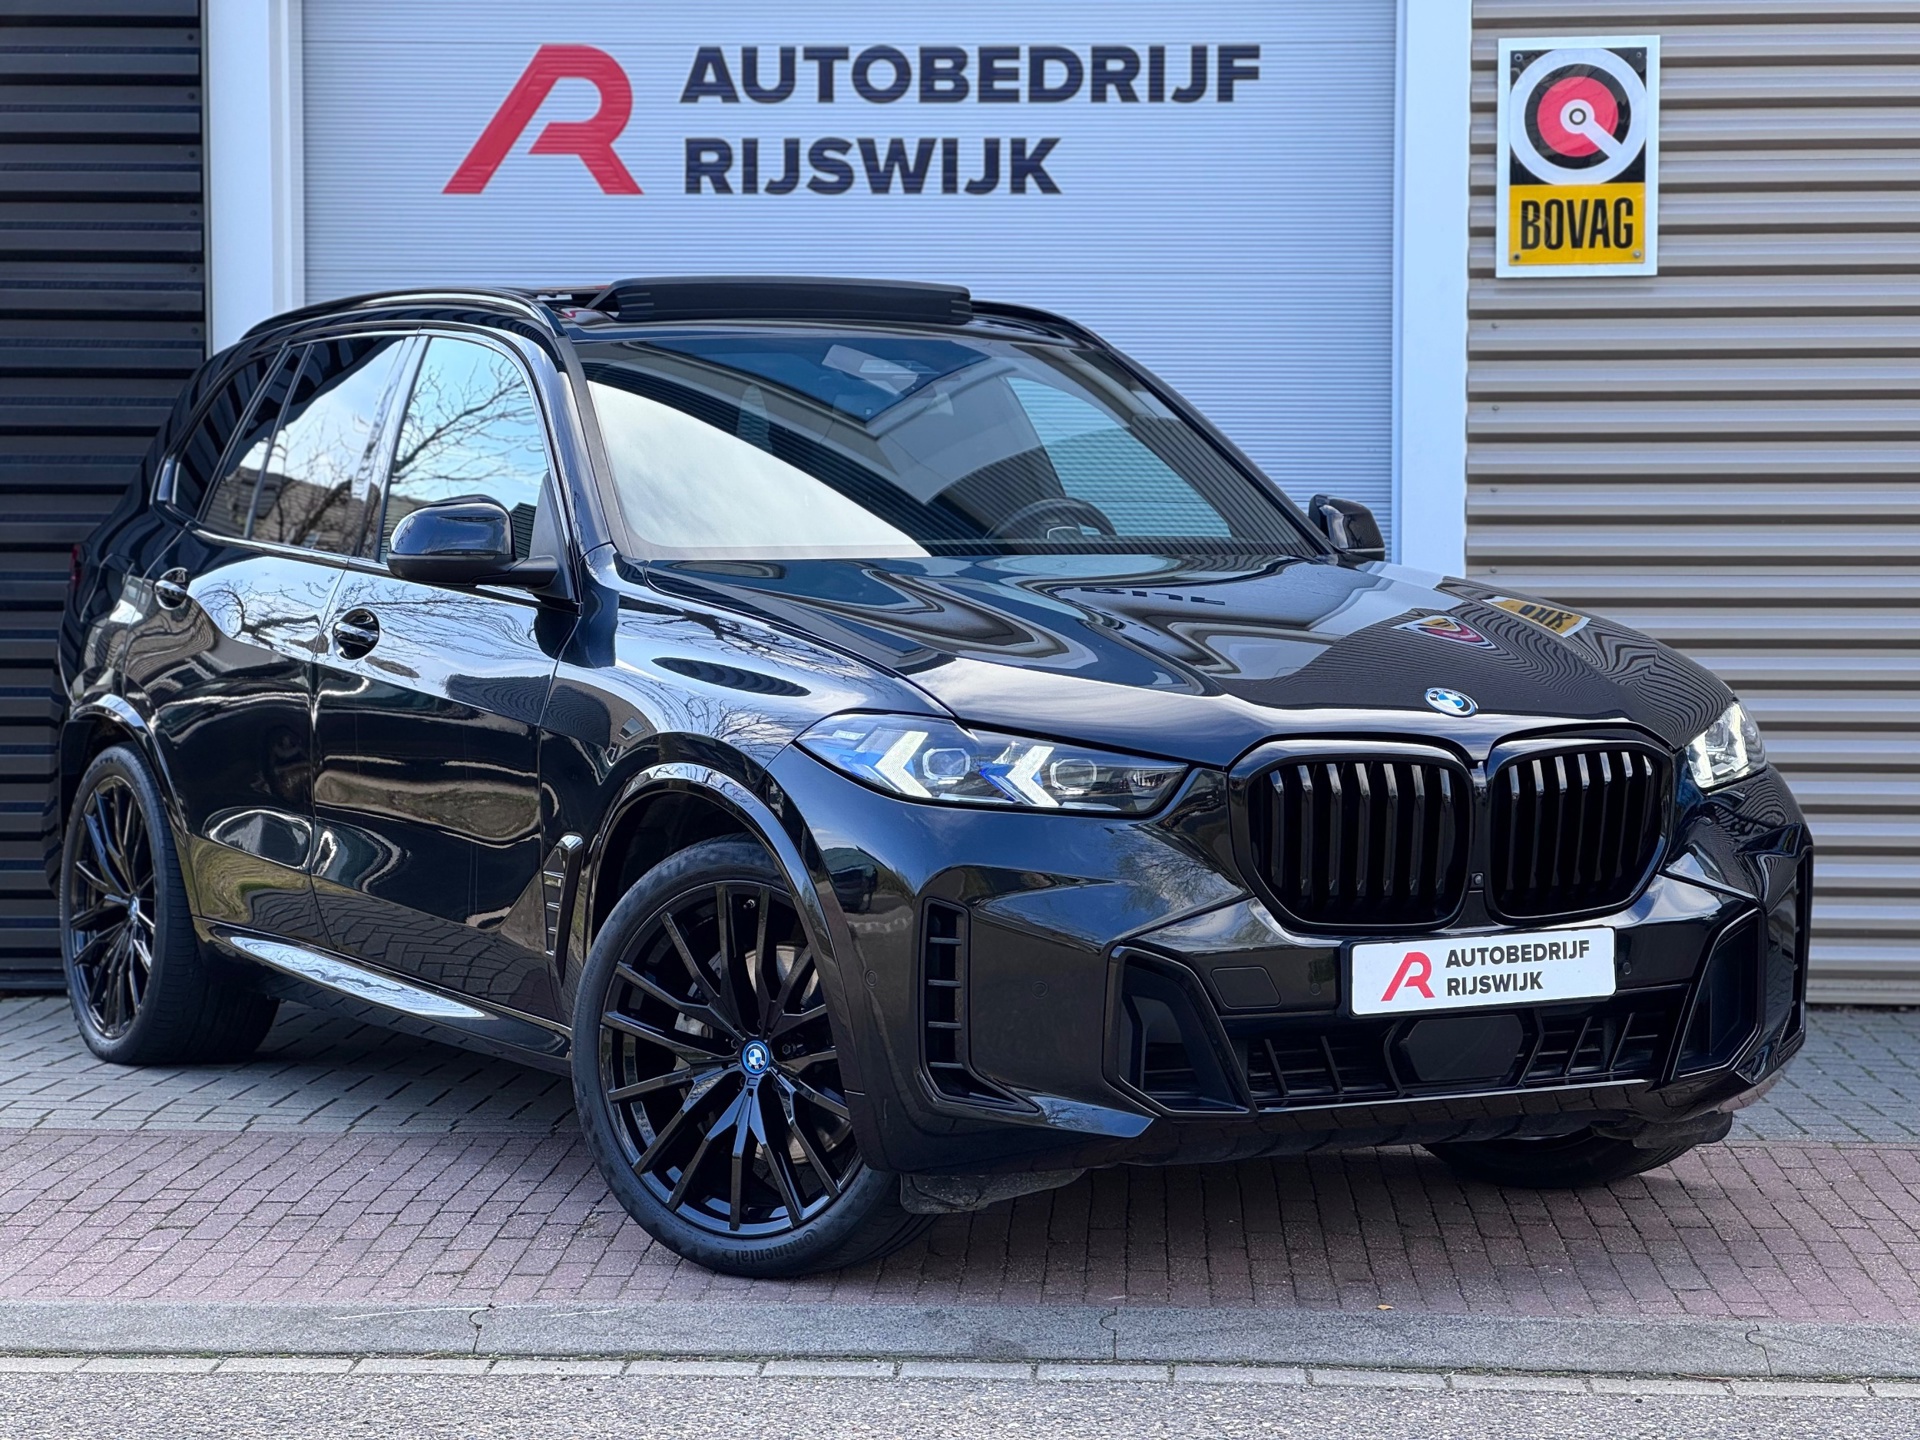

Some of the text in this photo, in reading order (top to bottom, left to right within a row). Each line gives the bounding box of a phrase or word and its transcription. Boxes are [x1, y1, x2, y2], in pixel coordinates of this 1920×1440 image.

[679, 44, 1262, 105] AUTOBEDRIJF
[684, 136, 1063, 196] RIJSWIJK
[1520, 197, 1634, 251] BOVAG
[1445, 939, 1590, 969] AUTOBEDRIJF
[1446, 970, 1544, 997] RIJSWIJK
